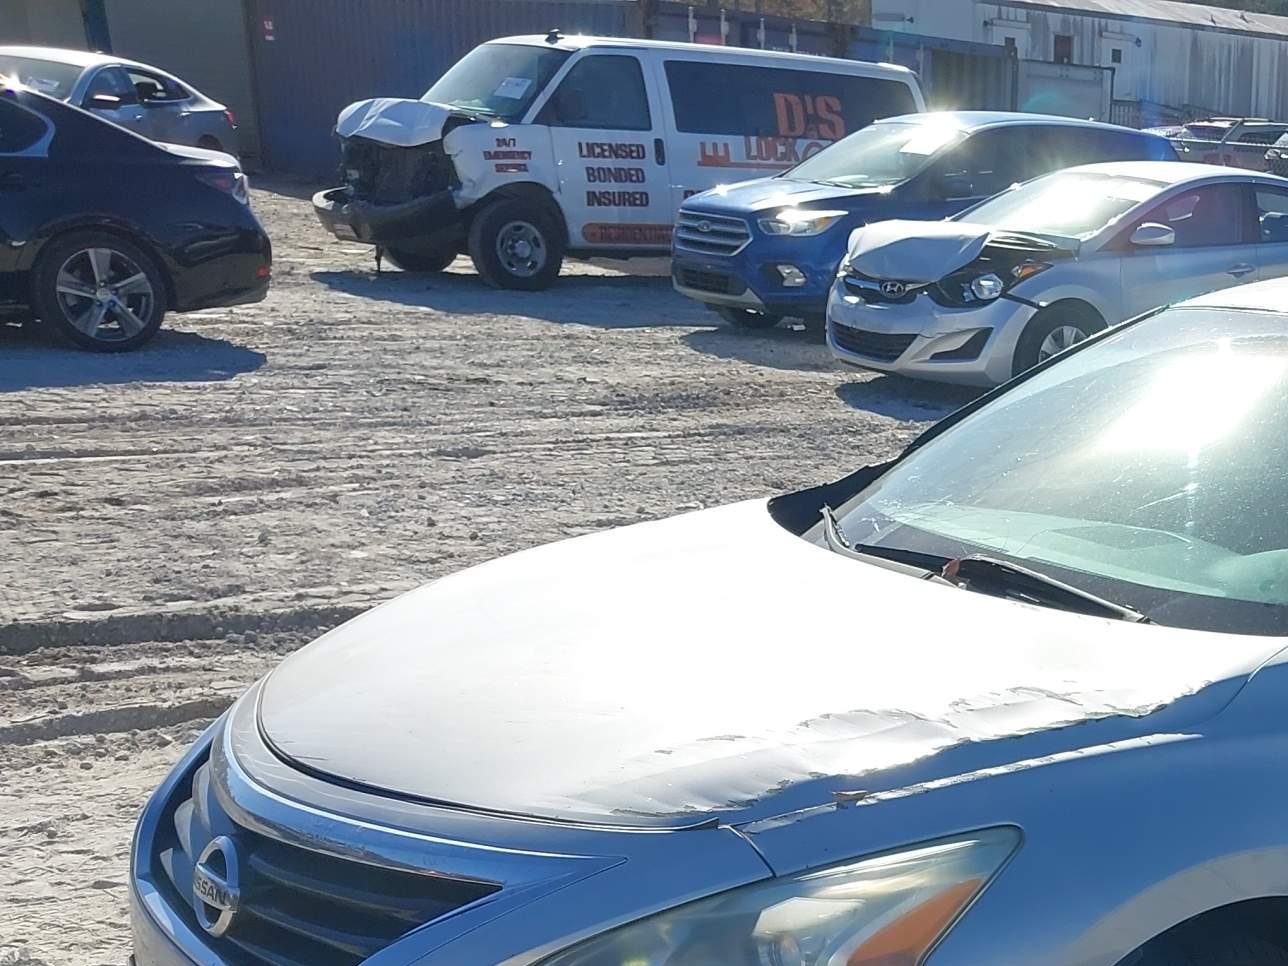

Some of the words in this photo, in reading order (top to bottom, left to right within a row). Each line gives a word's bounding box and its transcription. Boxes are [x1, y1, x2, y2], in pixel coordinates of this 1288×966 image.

[578, 142, 646, 160] LICENSED
[585, 166, 646, 184] BONDED
[586, 190, 649, 207] INSURED
